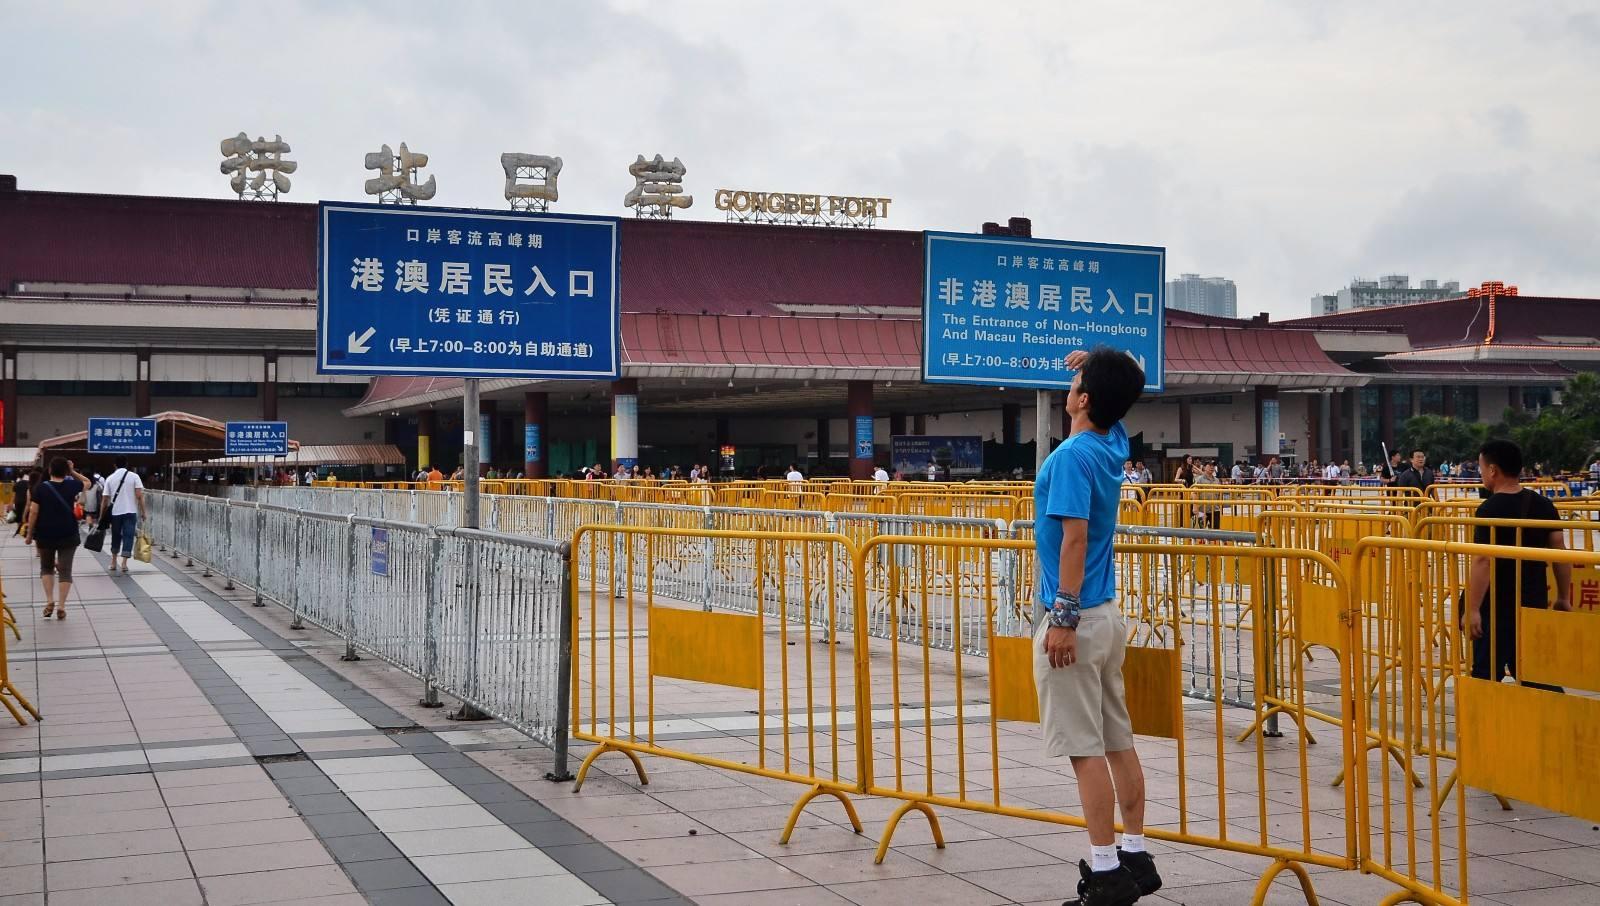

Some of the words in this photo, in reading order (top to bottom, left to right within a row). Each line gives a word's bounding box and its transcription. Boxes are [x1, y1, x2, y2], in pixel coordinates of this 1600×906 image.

[220, 131, 694, 217] 拱北口岸
[714, 189, 821, 215] GONGBEI
[829, 195, 892, 219] PORT
[406, 228, 543, 249] 口岸客流高峰期
[997, 255, 1100, 274] 口岸客流高峰期
[351, 257, 594, 298] 港澳居民入口
[938, 277, 1153, 316] 非港澳居民入口
[428, 307, 520, 325] (凭证通行)
[942, 313, 966, 326] The
[972, 315, 1029, 329] Entrance
[1035, 319, 1048, 330] of
[1053, 319, 1148, 337] Non-Hongkong
[942, 328, 968, 341] And
[974, 331, 1016, 343] Macau
[1022, 333, 1083, 346] Residents
[942, 353, 1077, 371] (早上7:00-8:00为非
